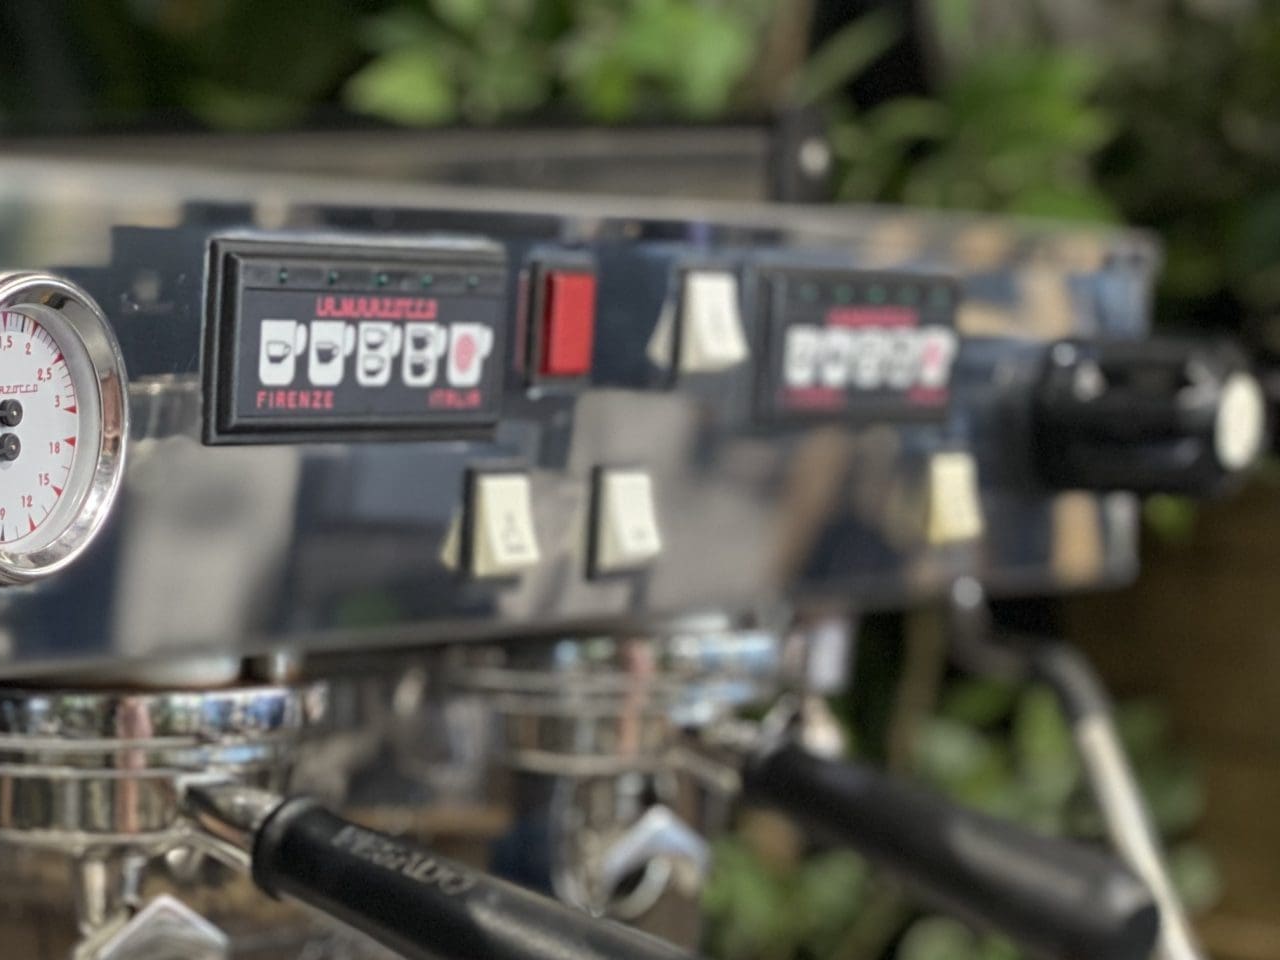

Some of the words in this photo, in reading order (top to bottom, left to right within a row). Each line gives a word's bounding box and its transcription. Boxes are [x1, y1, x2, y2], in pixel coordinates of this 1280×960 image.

[25, 343, 31, 355] 2
[55, 395, 60, 408] 3
[50, 442, 60, 454] 18
[39, 473, 50, 485] 15
[21, 495, 33, 507] 12
[0, 508, 6, 520] 9
